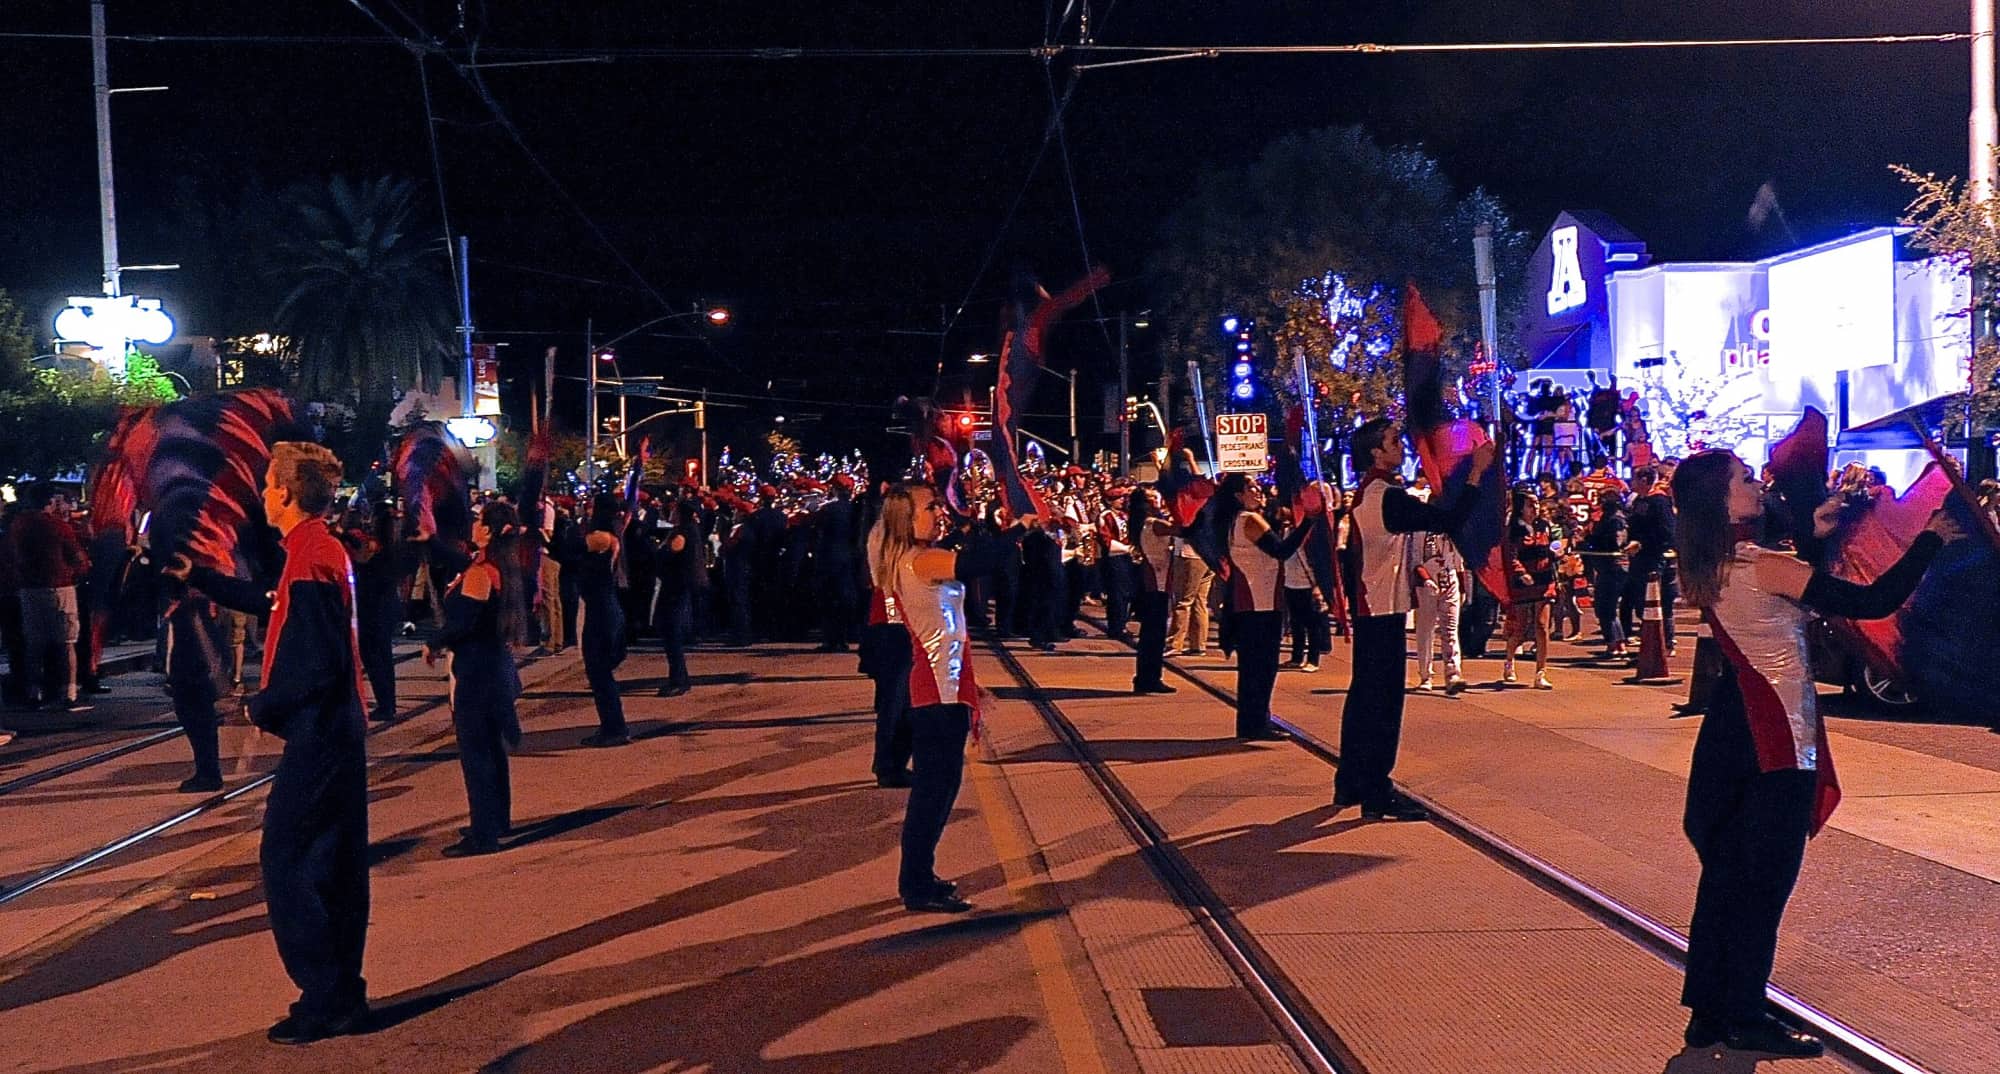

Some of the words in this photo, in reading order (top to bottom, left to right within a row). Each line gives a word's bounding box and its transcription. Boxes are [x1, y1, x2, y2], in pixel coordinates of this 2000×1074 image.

[1547, 226, 1587, 315] A
[1219, 415, 1263, 434] STOP
[1221, 442, 1264, 451] PEDESTRIANS
[1223, 459, 1263, 467] CROSSWALK
